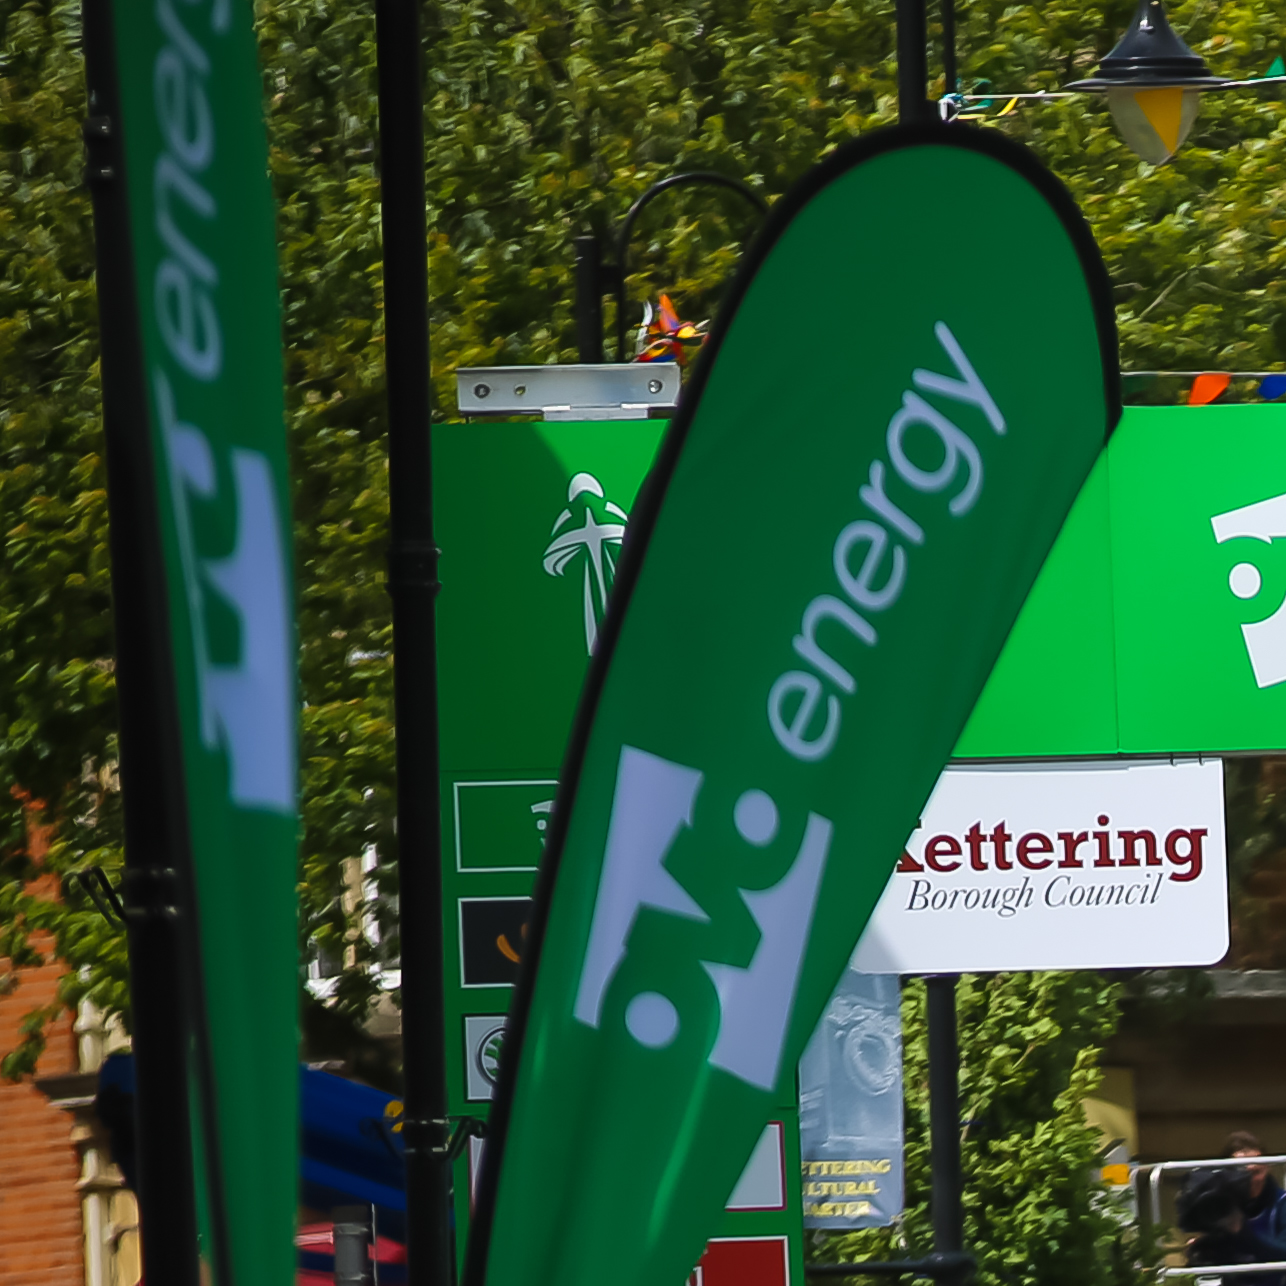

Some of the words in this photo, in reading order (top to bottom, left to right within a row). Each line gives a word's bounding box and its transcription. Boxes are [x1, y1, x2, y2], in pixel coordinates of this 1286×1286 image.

[767, 320, 1008, 761] energy
[905, 876, 1034, 918] Borough
[1044, 873, 1164, 908] Council
